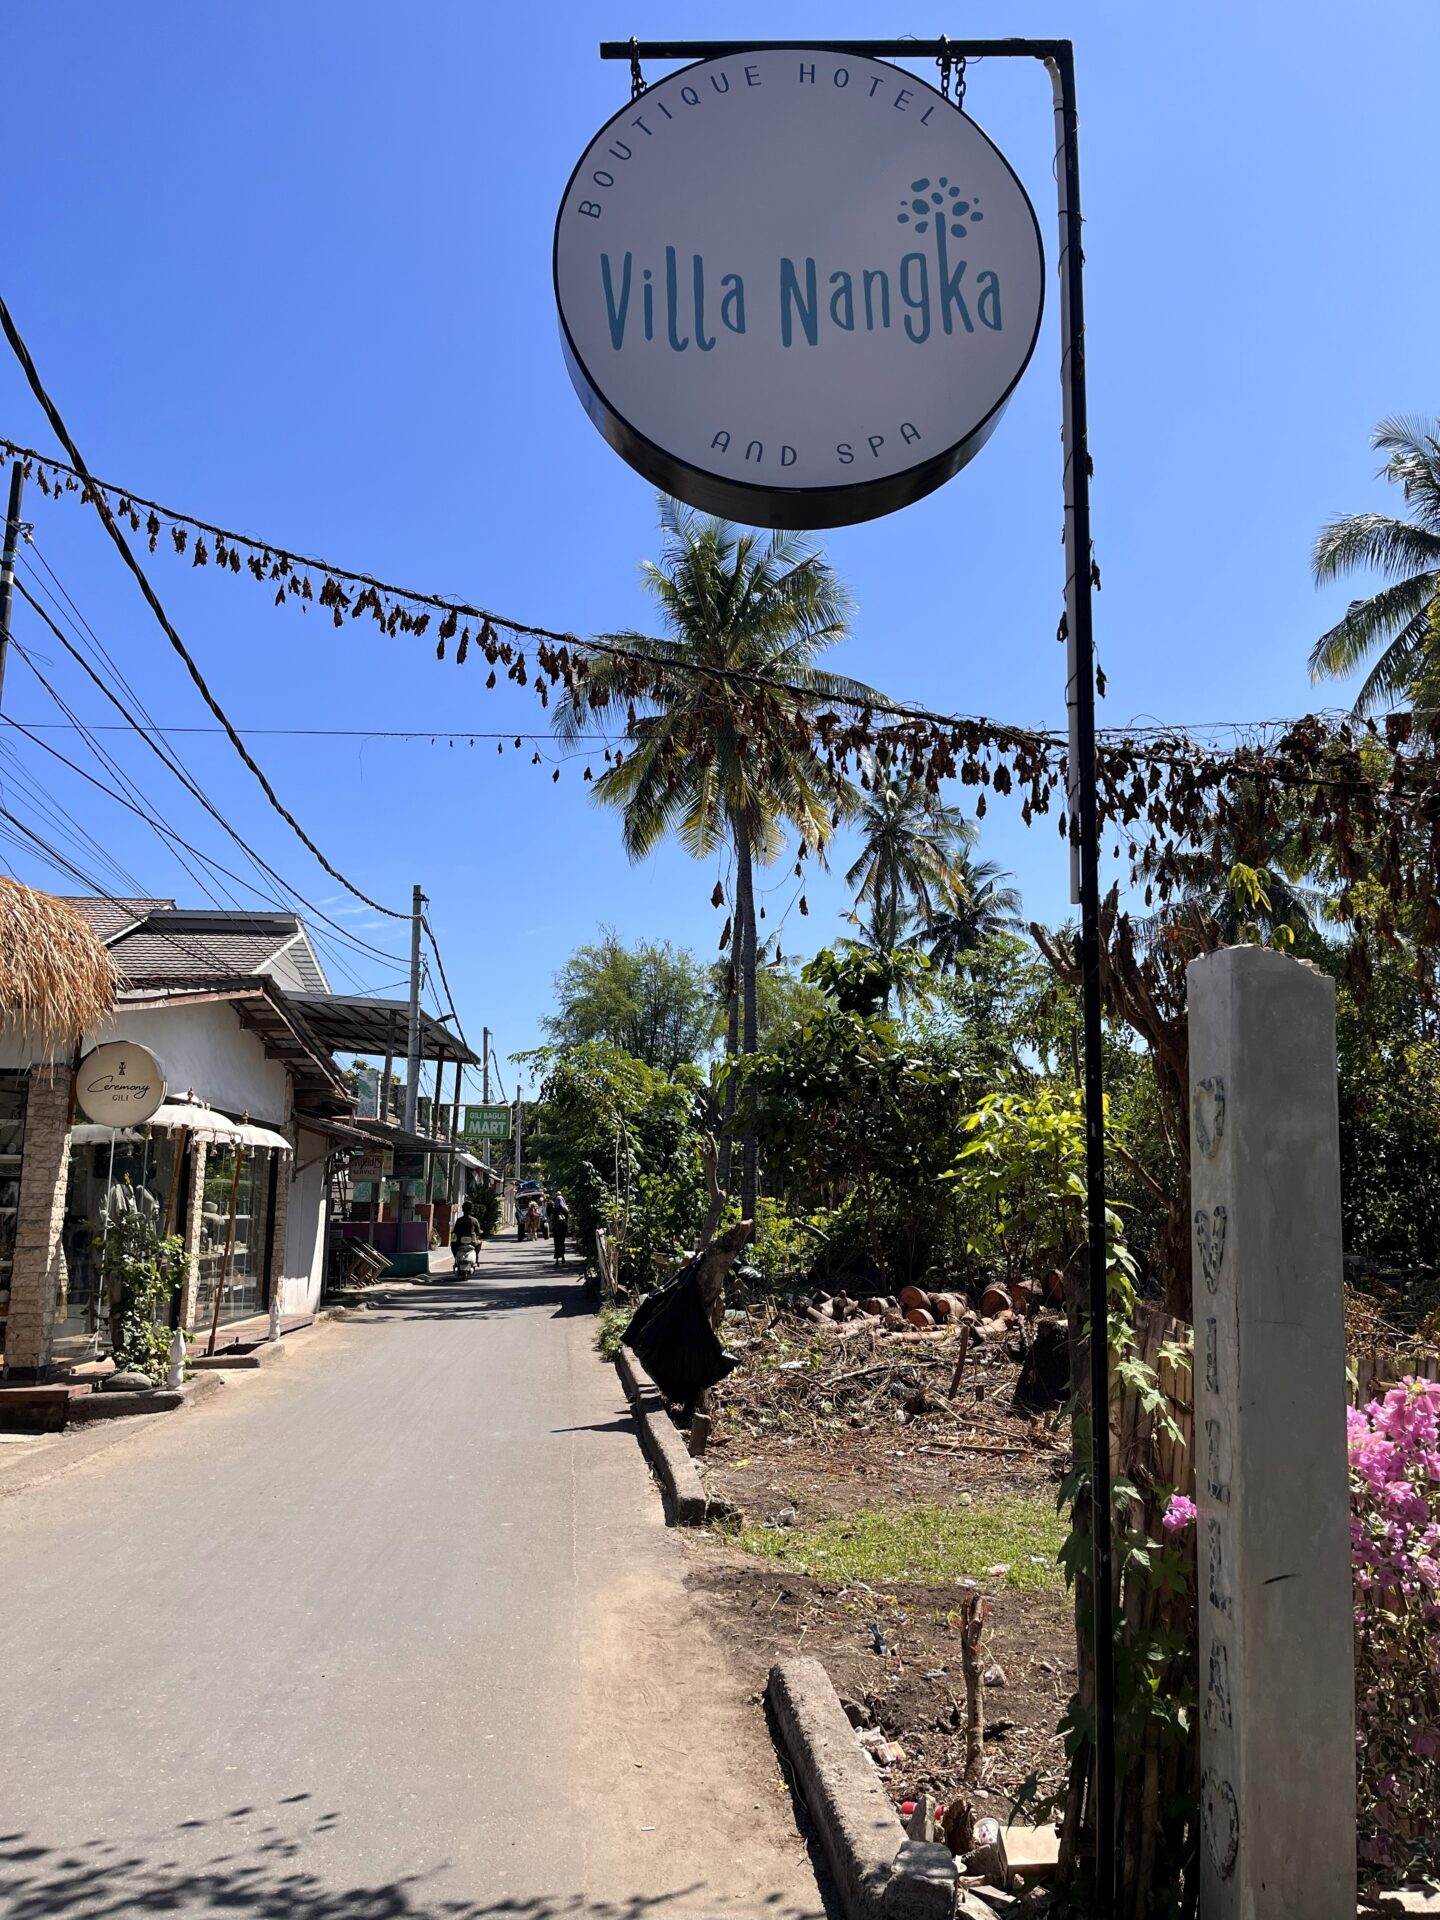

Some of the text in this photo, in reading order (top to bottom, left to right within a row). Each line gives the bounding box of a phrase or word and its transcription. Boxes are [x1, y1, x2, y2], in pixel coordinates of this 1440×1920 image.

[578, 63, 935, 219] BOUTIQUE HOTEL
[600, 211, 1003, 353] Villa Nangka
[836, 422, 922, 465] SPA
[87, 1075, 150, 1099] Ceremony
[468, 1121, 507, 1134] MART
[483, 1112, 507, 1120] BAGUS
